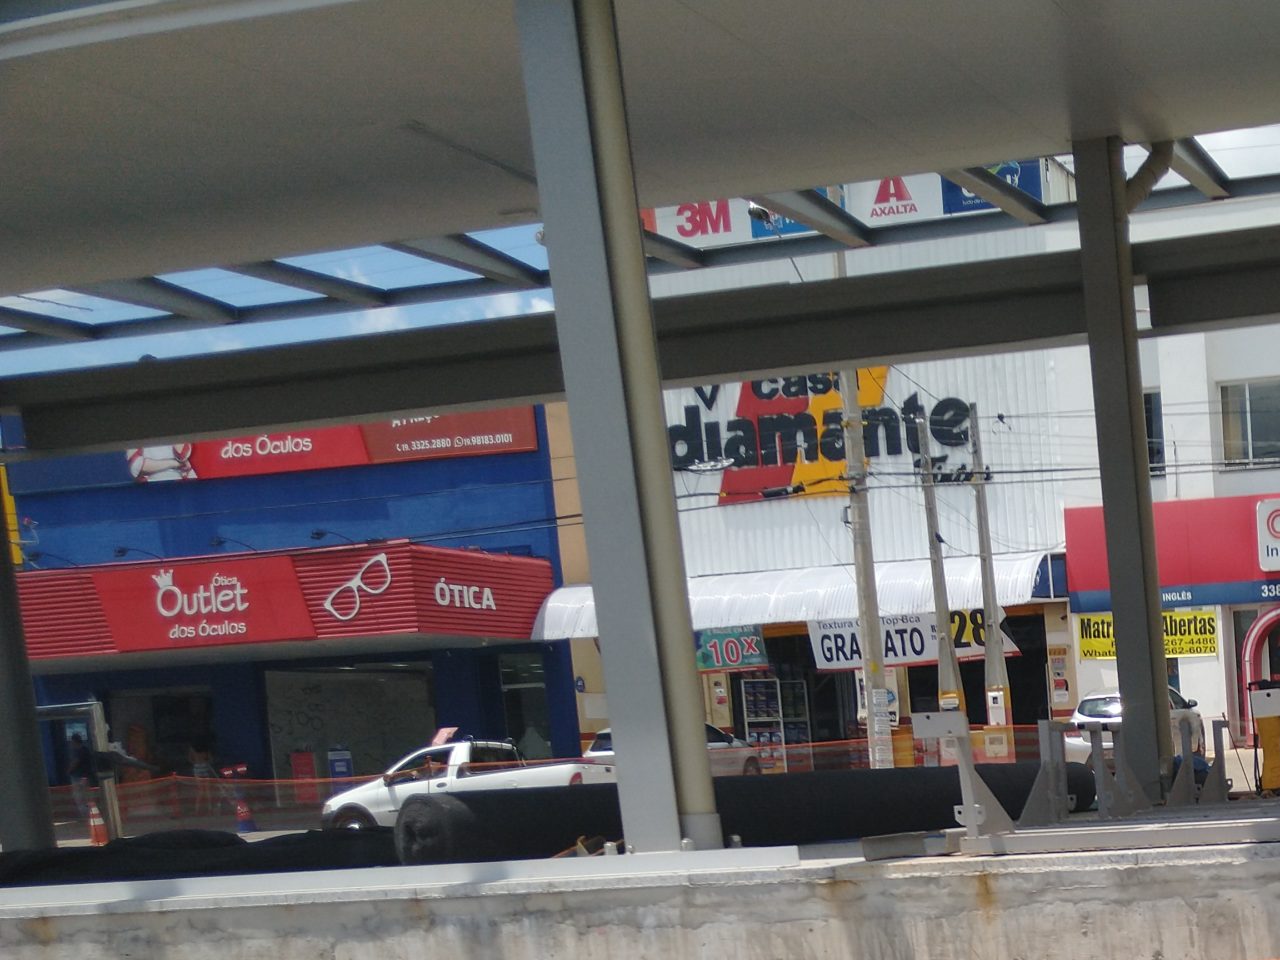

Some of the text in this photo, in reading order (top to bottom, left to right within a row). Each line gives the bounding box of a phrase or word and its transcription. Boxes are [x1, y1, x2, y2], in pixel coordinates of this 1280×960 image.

[676, 198, 732, 238] 3M
[870, 202, 918, 219] AXALTA
[667, 391, 970, 468] diamante
[220, 434, 313, 459] dos Óculos
[411, 438, 451, 451] 3325.2880
[213, 573, 238, 587] Ótica
[157, 582, 249, 617] Outlet
[435, 577, 497, 611] ÓTICA
[1162, 591, 1192, 602] INGLÊS
[169, 620, 247, 639] dos Óculos
[881, 616, 899, 627] Top
[949, 608, 986, 649] 28
[1162, 614, 1216, 637] Abertas
[821, 627, 925, 663] GRAATO
[1165, 637, 1216, 647] 267-4486
[1165, 646, 1216, 655] 562-6070
